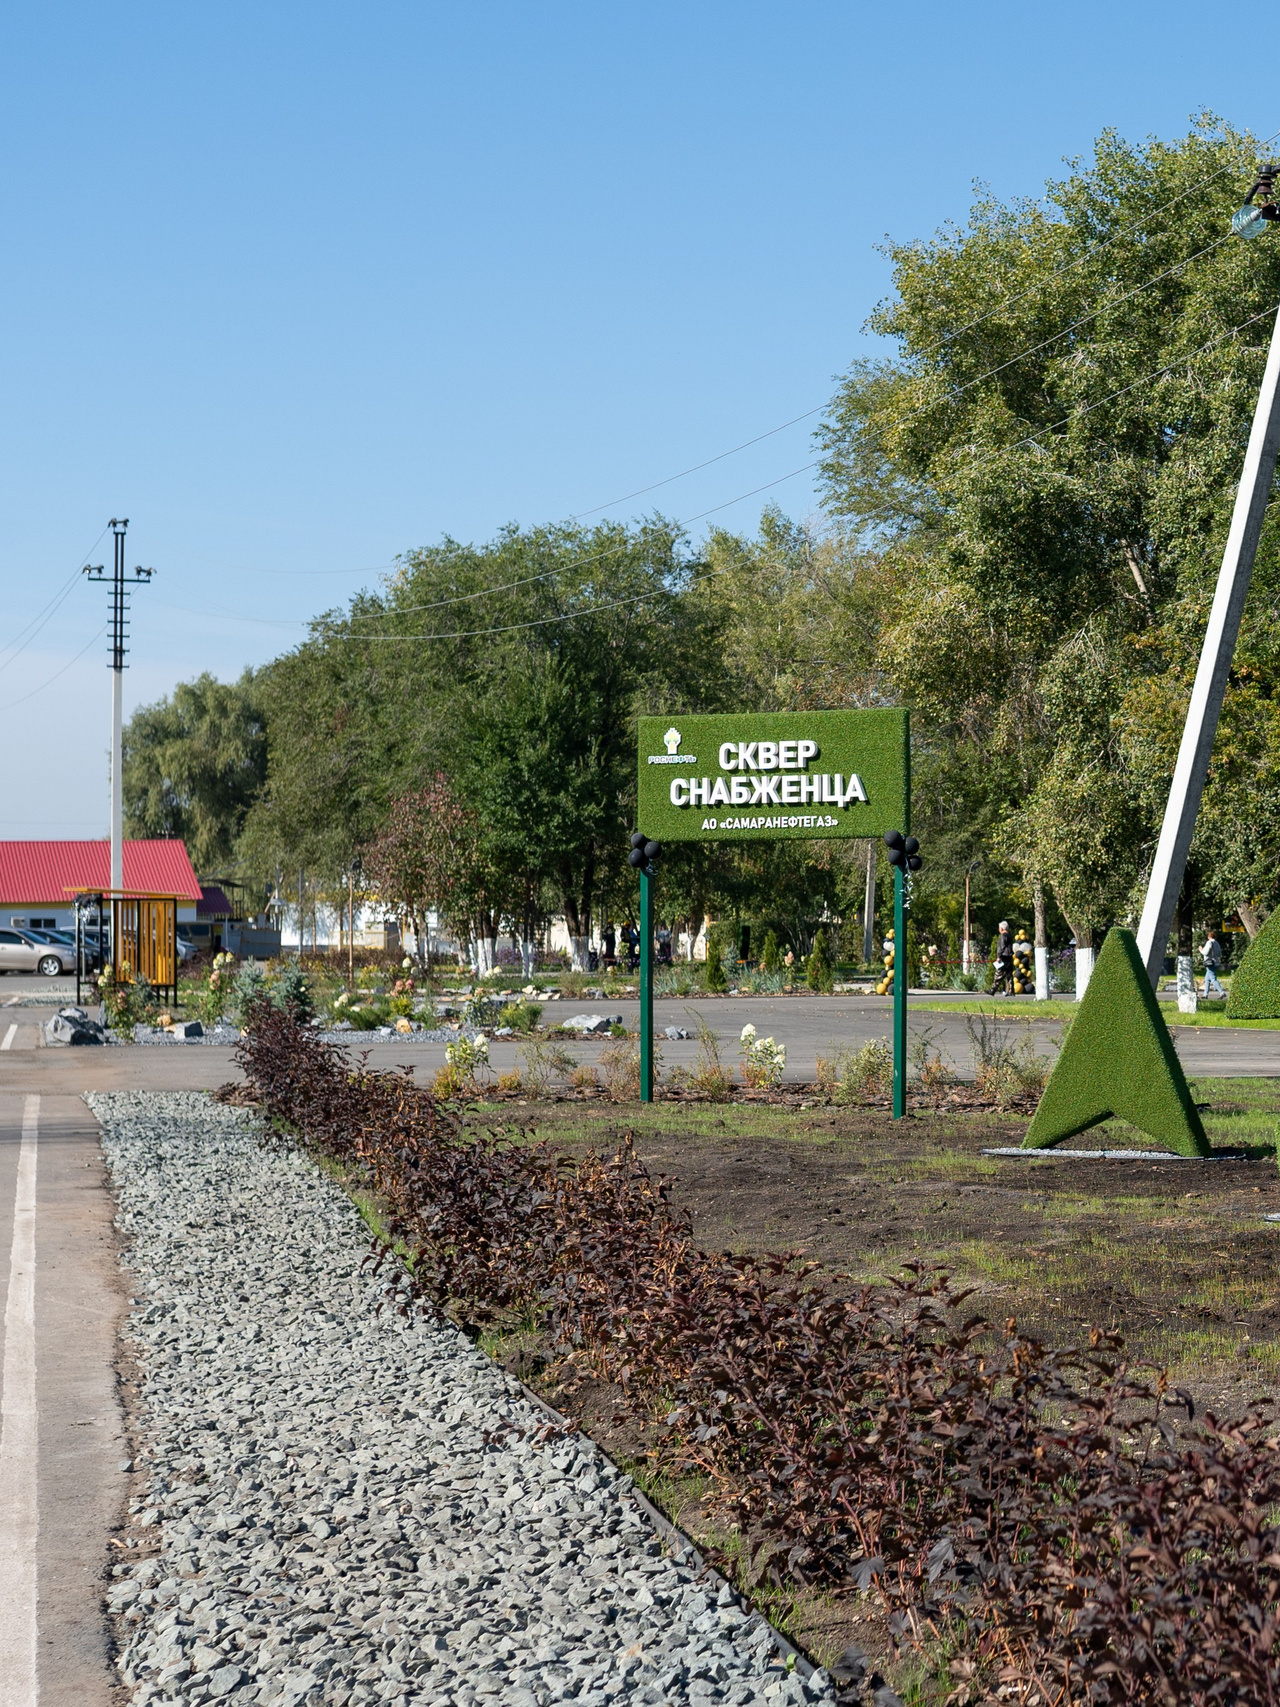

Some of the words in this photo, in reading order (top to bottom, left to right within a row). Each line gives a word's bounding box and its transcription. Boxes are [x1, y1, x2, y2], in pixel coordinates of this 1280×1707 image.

[648, 755, 697, 764] РОСНЕФТЬ
[719, 740, 819, 771] СКВЕР
[670, 773, 868, 807] СНАБЖЕНЦА
[701, 818, 717, 830] АО
[719, 815, 839, 829] «САМАРАНЕФТЕГАЗ»
